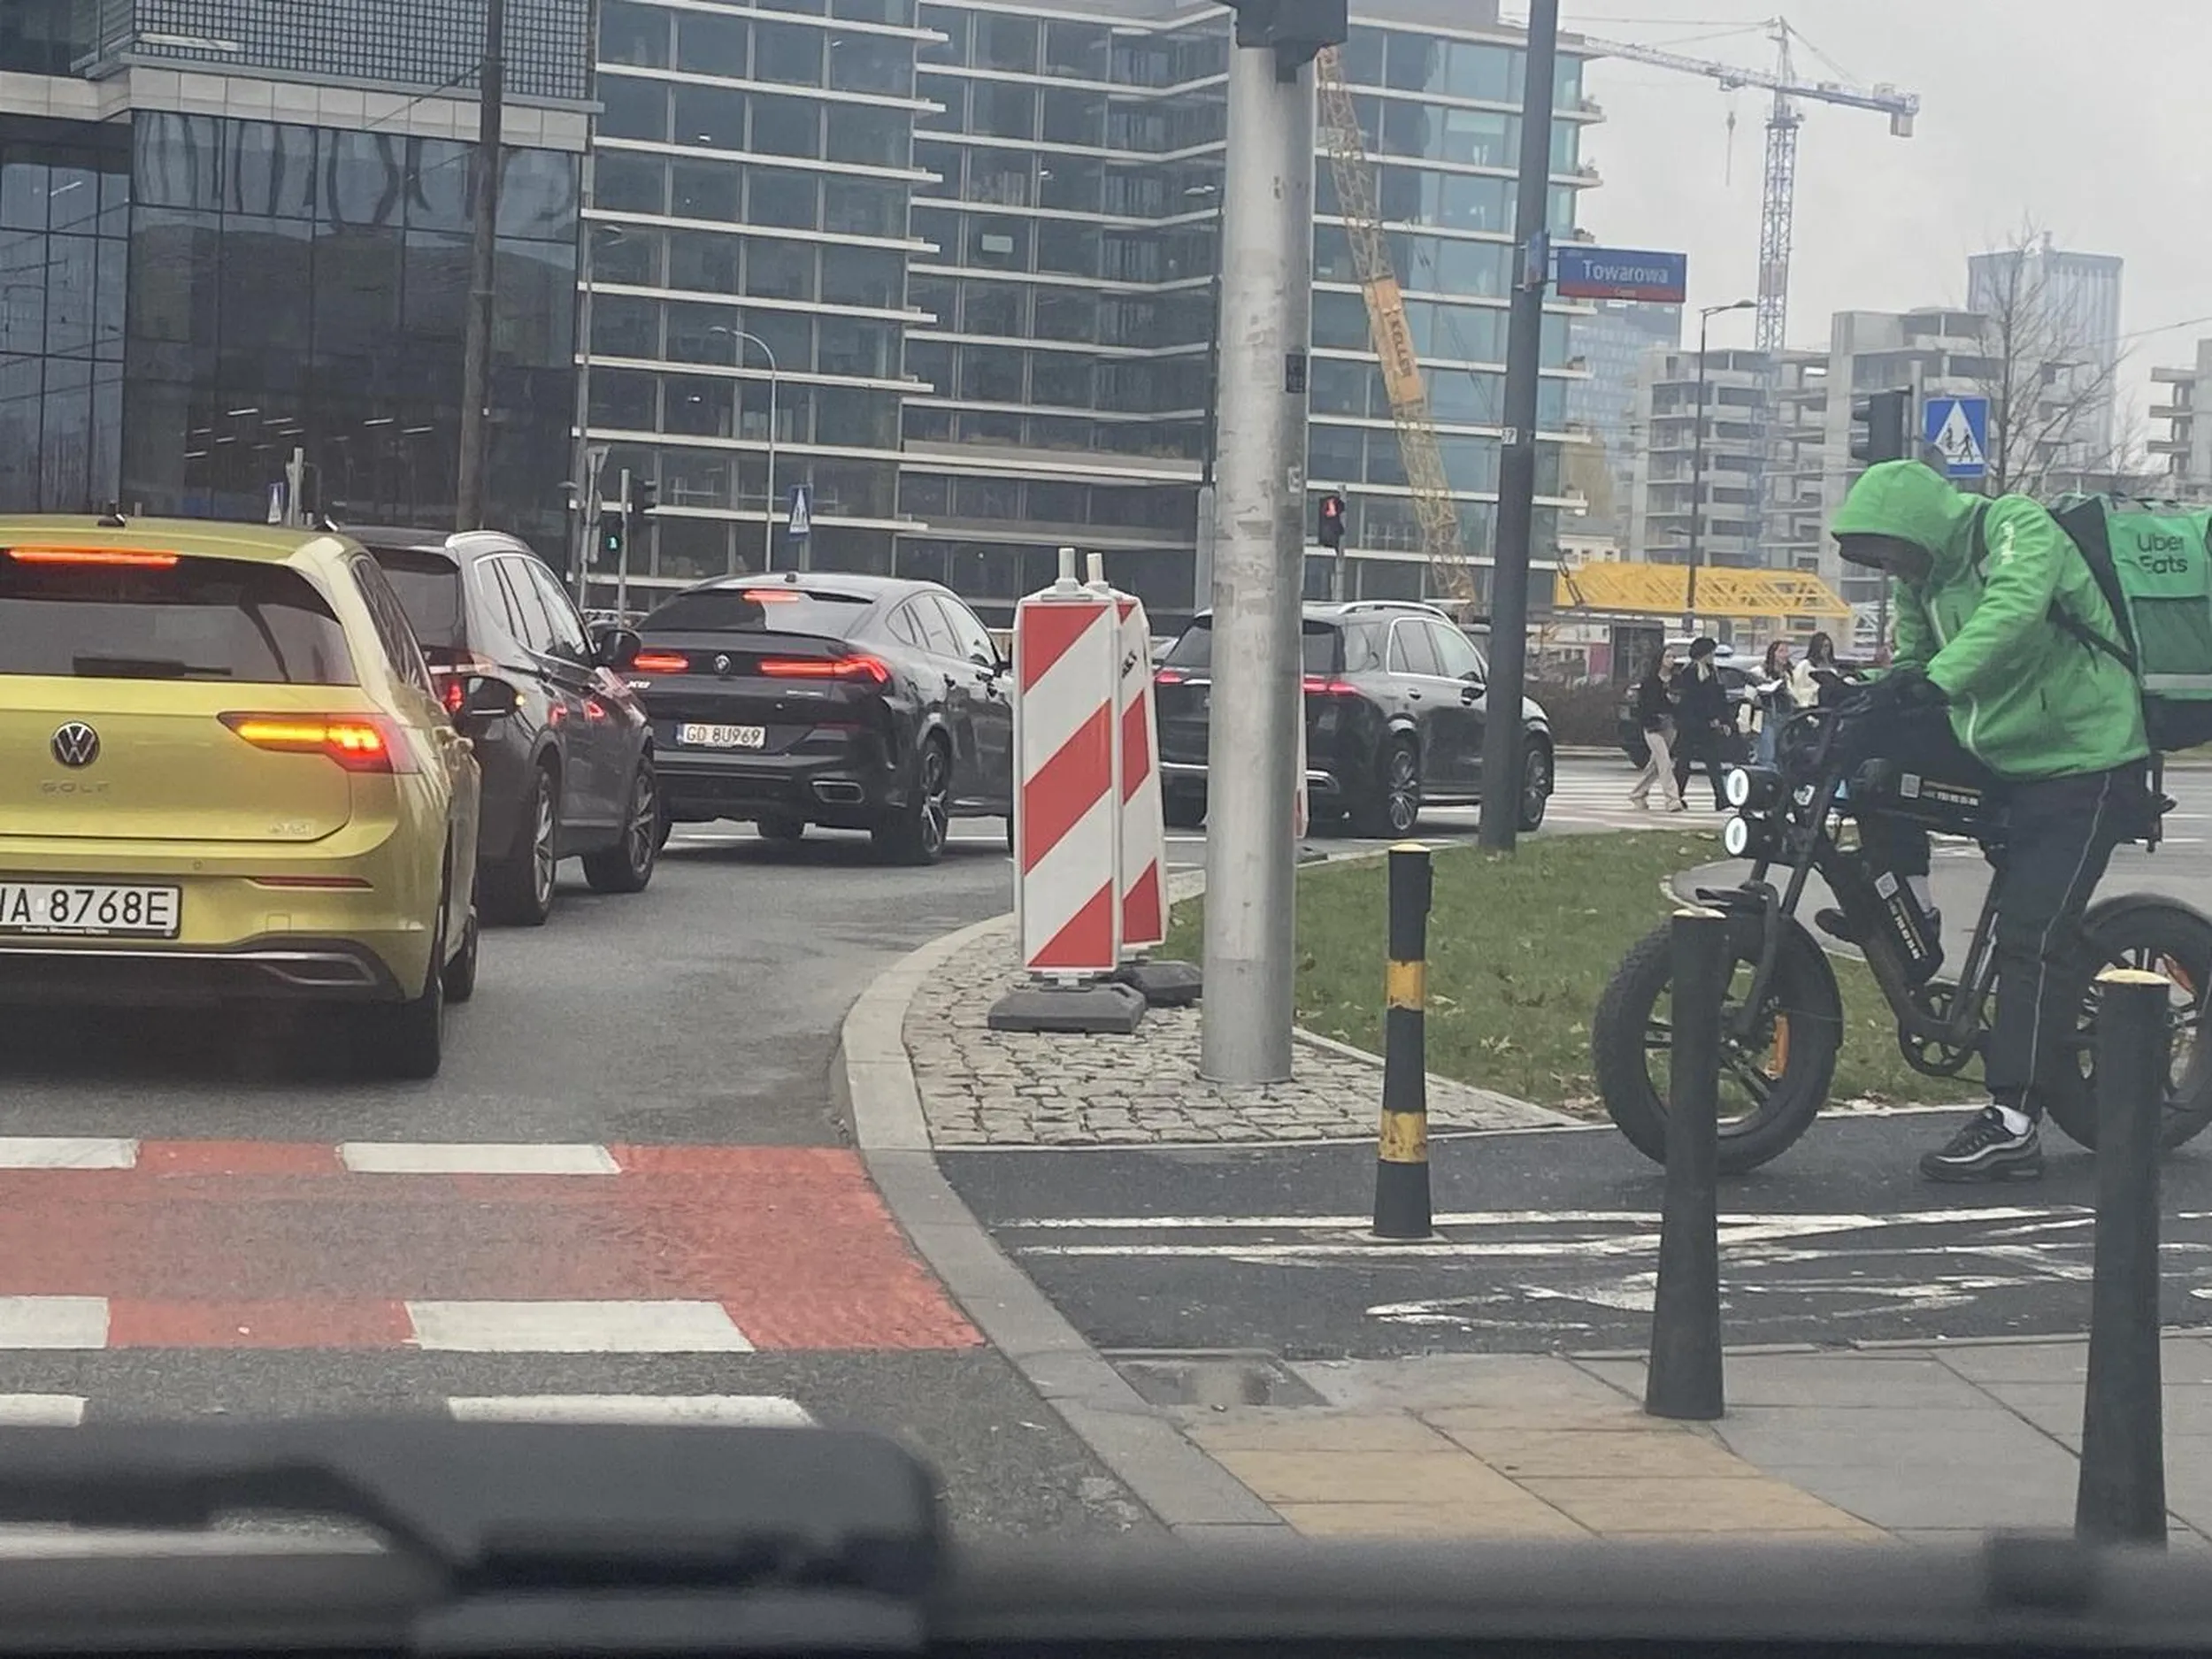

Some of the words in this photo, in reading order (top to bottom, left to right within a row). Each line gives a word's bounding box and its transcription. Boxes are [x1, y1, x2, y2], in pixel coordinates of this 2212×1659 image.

[1582, 259, 1669, 284] Towarowa
[2137, 533, 2184, 552] Uber
[2139, 556, 2188, 574] Eats
[687, 726, 707, 741] GD
[711, 727, 761, 743] 8U969
[42, 781, 110, 794] GOLF
[50, 888, 169, 926] 8768E
